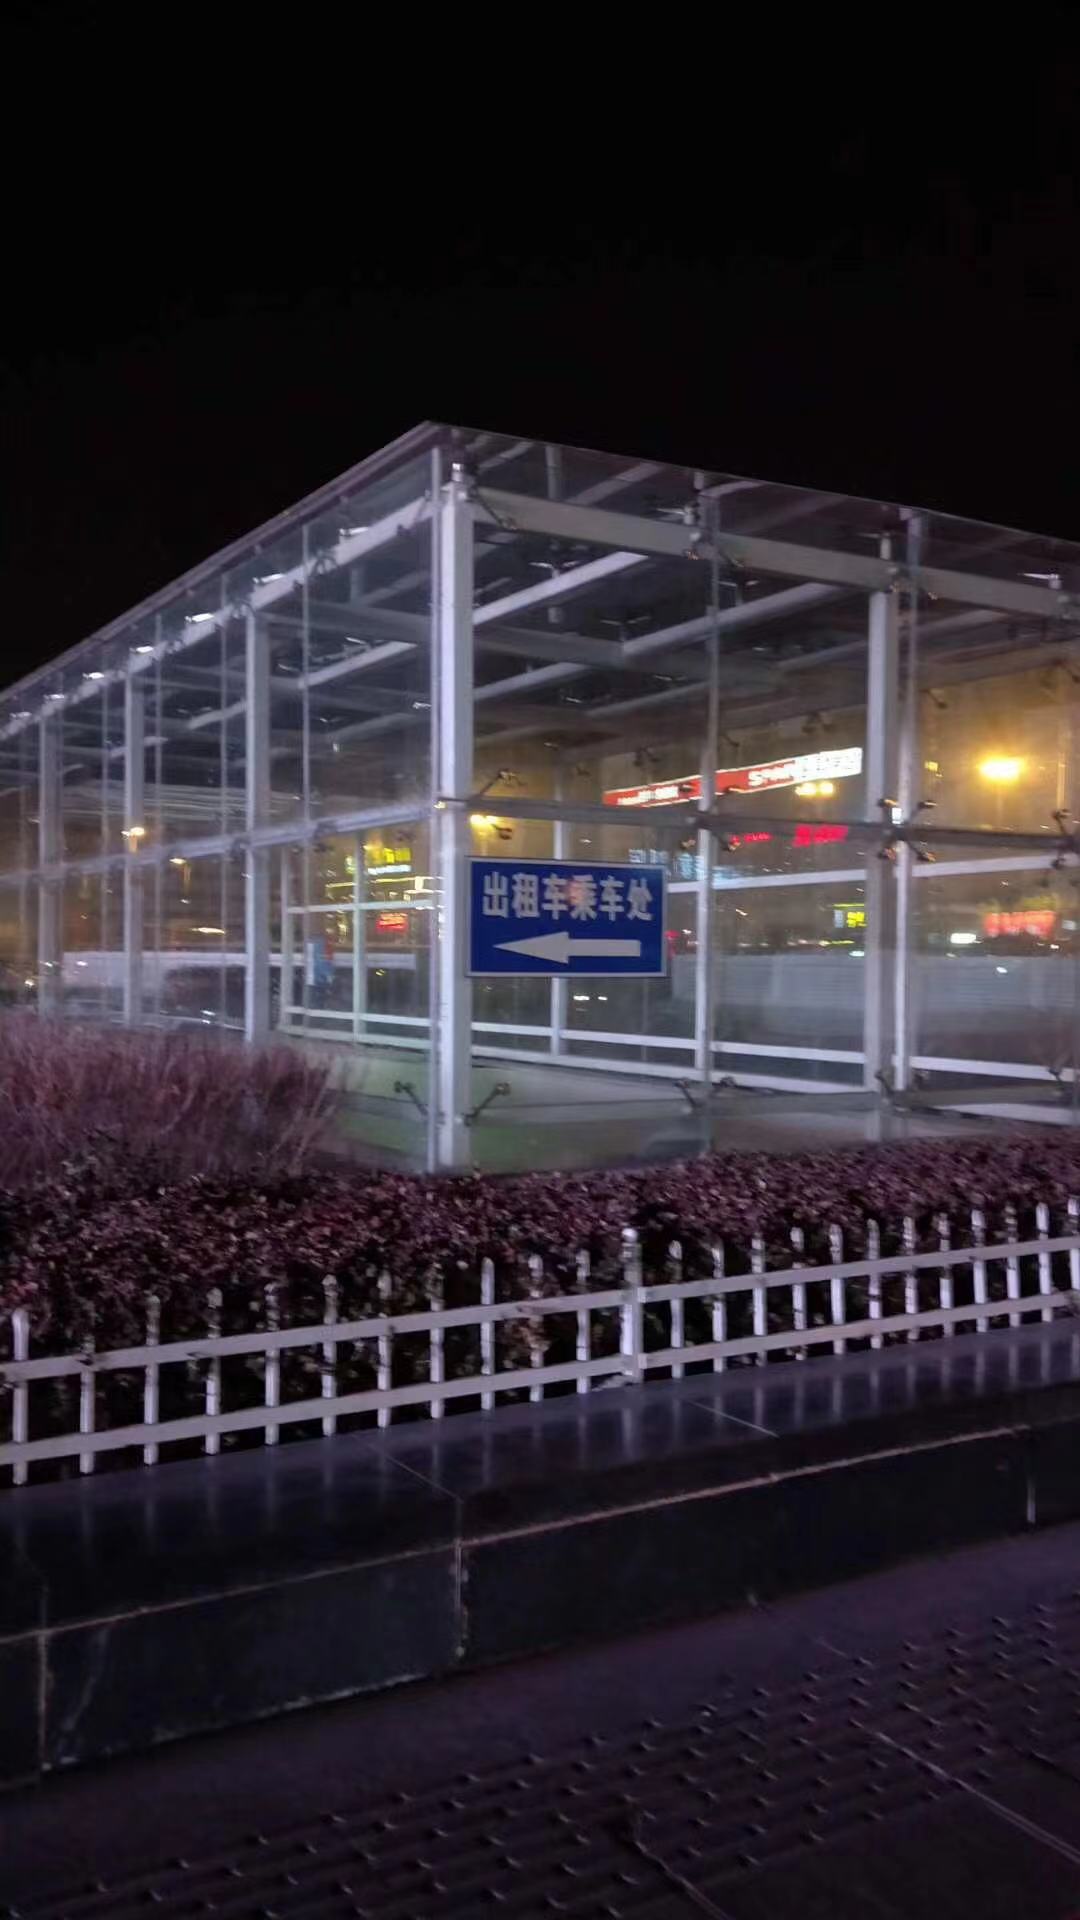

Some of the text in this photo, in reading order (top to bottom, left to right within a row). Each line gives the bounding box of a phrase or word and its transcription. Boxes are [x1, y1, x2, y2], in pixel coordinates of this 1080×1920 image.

[482, 871, 653, 922] 出租车乘车处
